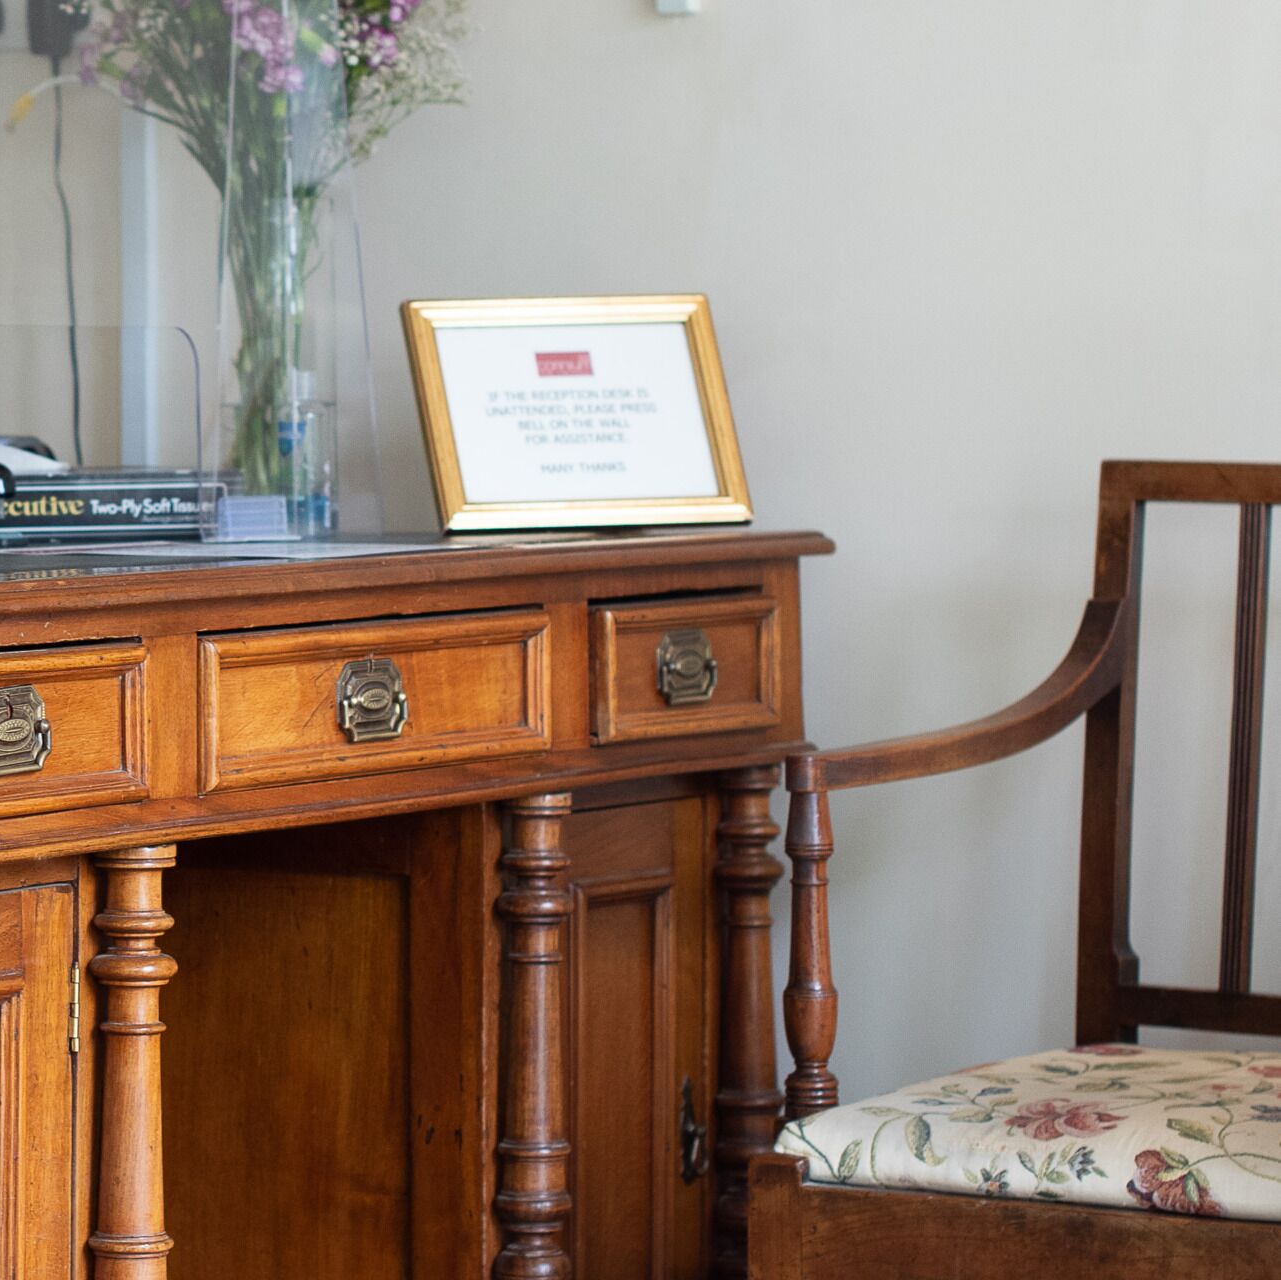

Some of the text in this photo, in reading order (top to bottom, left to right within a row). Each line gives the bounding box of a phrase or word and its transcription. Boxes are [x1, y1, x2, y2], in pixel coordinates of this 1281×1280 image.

[489, 388, 649, 401] IF THE RECEPTION DESK IS
[574, 404, 616, 414] PLEASE
[620, 402, 657, 414] PRESS
[518, 418, 630, 431] BELL ON THE WALL
[525, 434, 548, 445] FOR
[541, 462, 627, 474] MANY THANKS
[2, 496, 85, 516] cutive
[89, 498, 142, 518] Two-Ply
[142, 497, 171, 515] Soft
